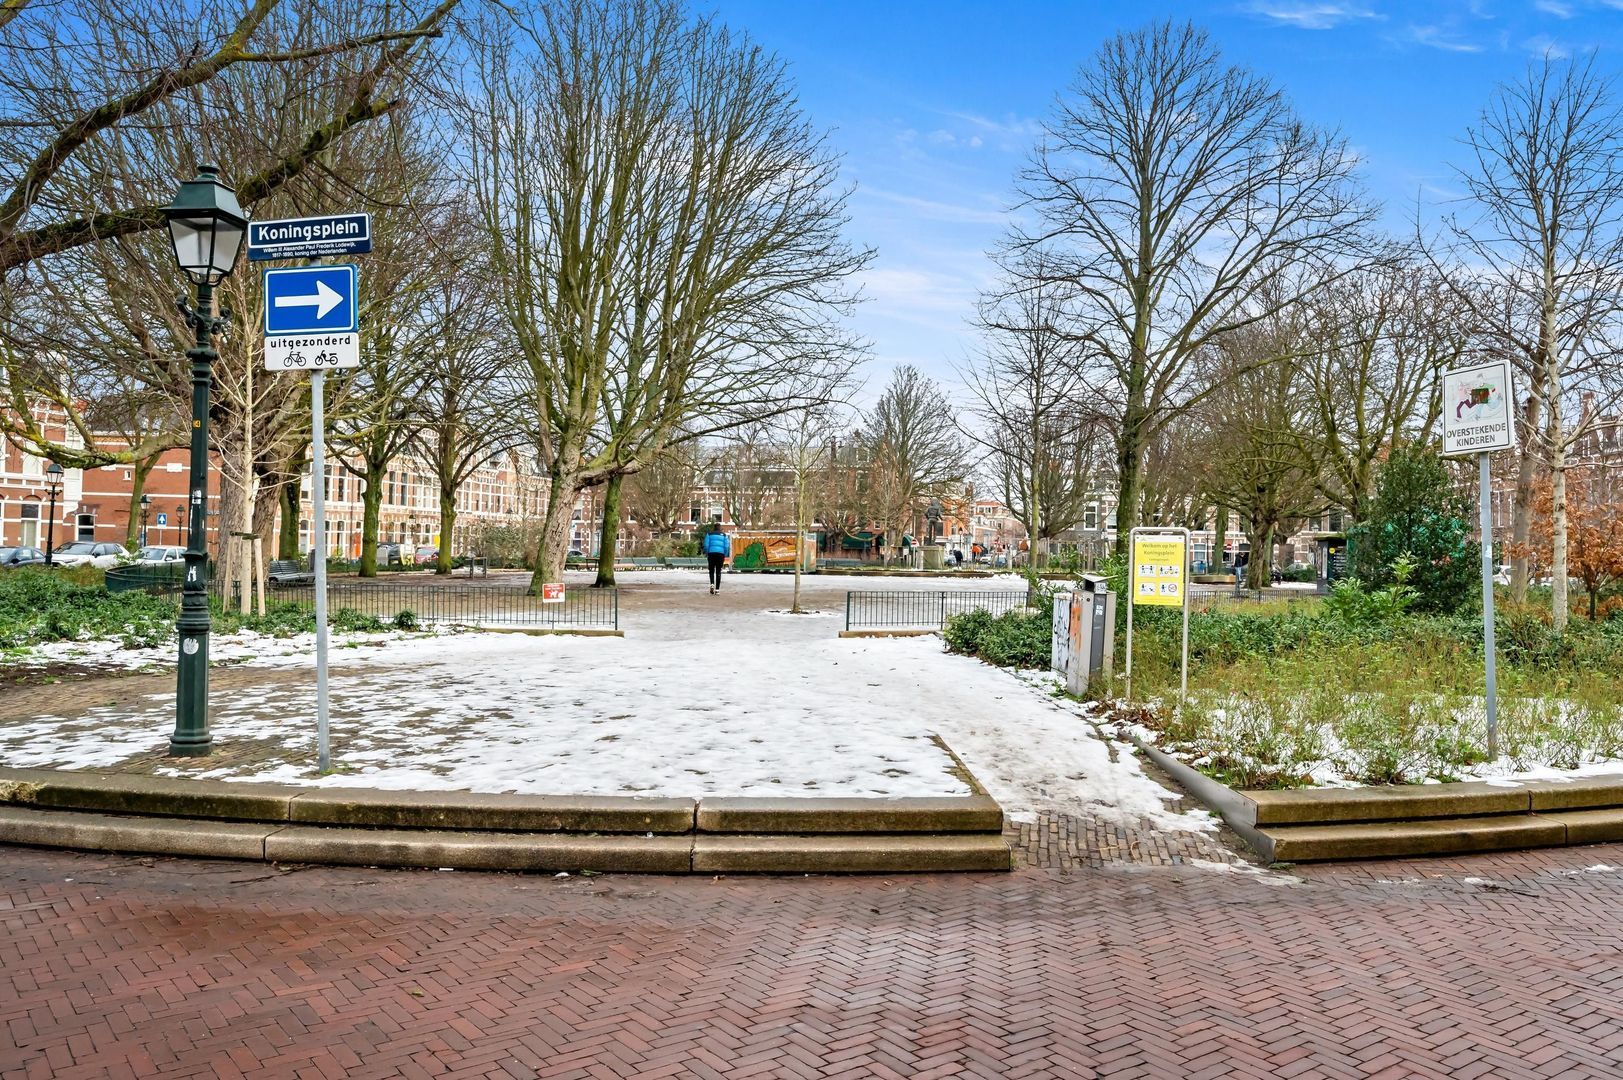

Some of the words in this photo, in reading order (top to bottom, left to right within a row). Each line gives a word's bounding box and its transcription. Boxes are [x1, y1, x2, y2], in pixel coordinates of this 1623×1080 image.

[258, 220, 359, 241] Koningsplein
[270, 335, 351, 350] uitgezonderd
[1446, 422, 1506, 439] OVERSTEKENDE
[1456, 434, 1496, 447] KINDEREN
